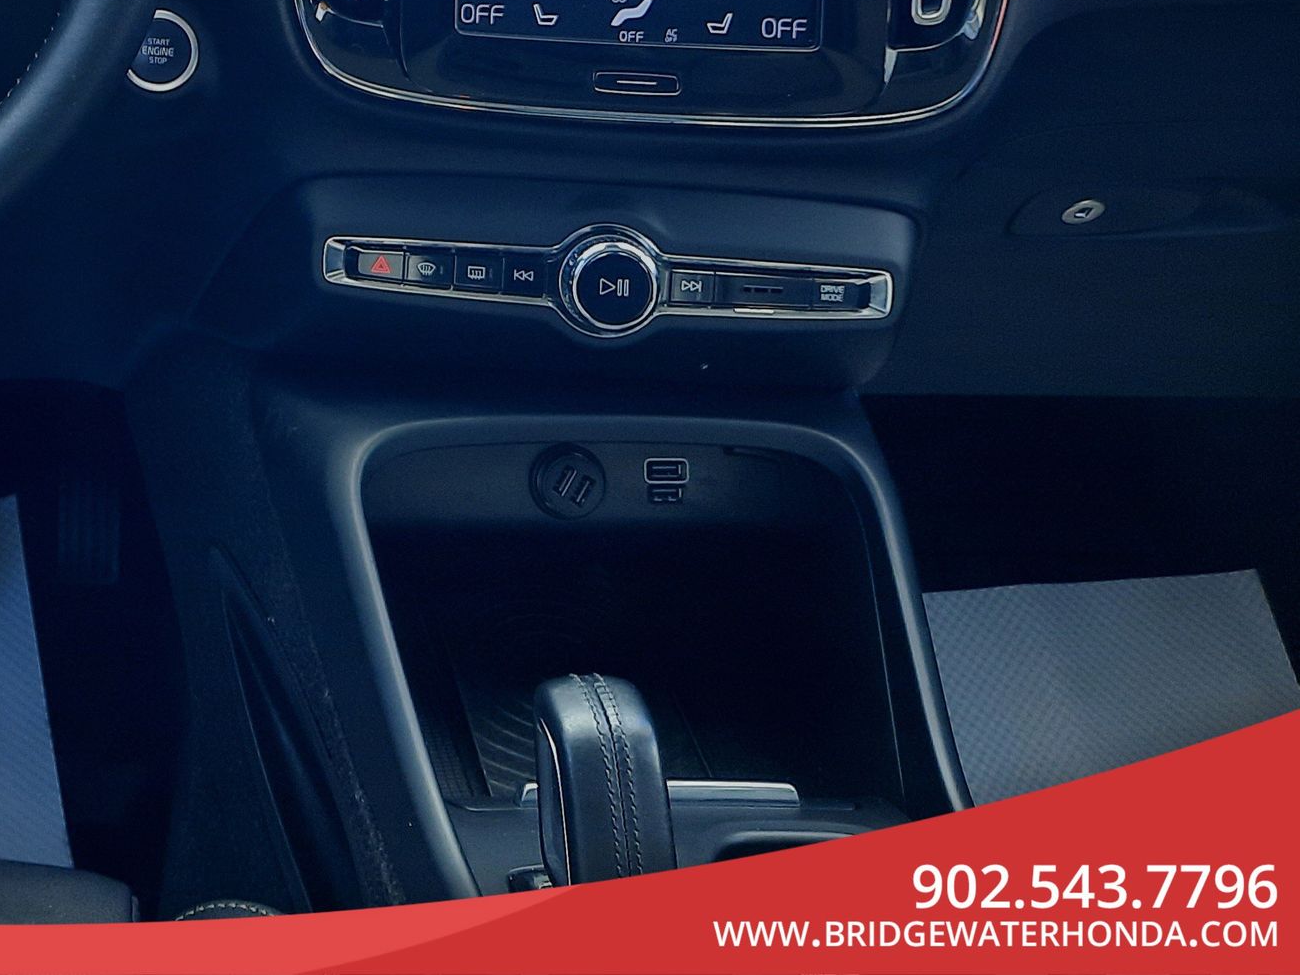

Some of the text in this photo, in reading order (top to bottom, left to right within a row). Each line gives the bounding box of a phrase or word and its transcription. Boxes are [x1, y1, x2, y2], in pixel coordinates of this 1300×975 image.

[460, 2, 506, 25] OFF
[761, 16, 809, 39] OFF
[147, 37, 170, 45] START
[619, 30, 644, 43] OFF
[141, 45, 174, 57] ENGINE
[148, 56, 168, 64] STOP
[820, 284, 845, 294] DRIVE
[820, 293, 844, 303] MODE
